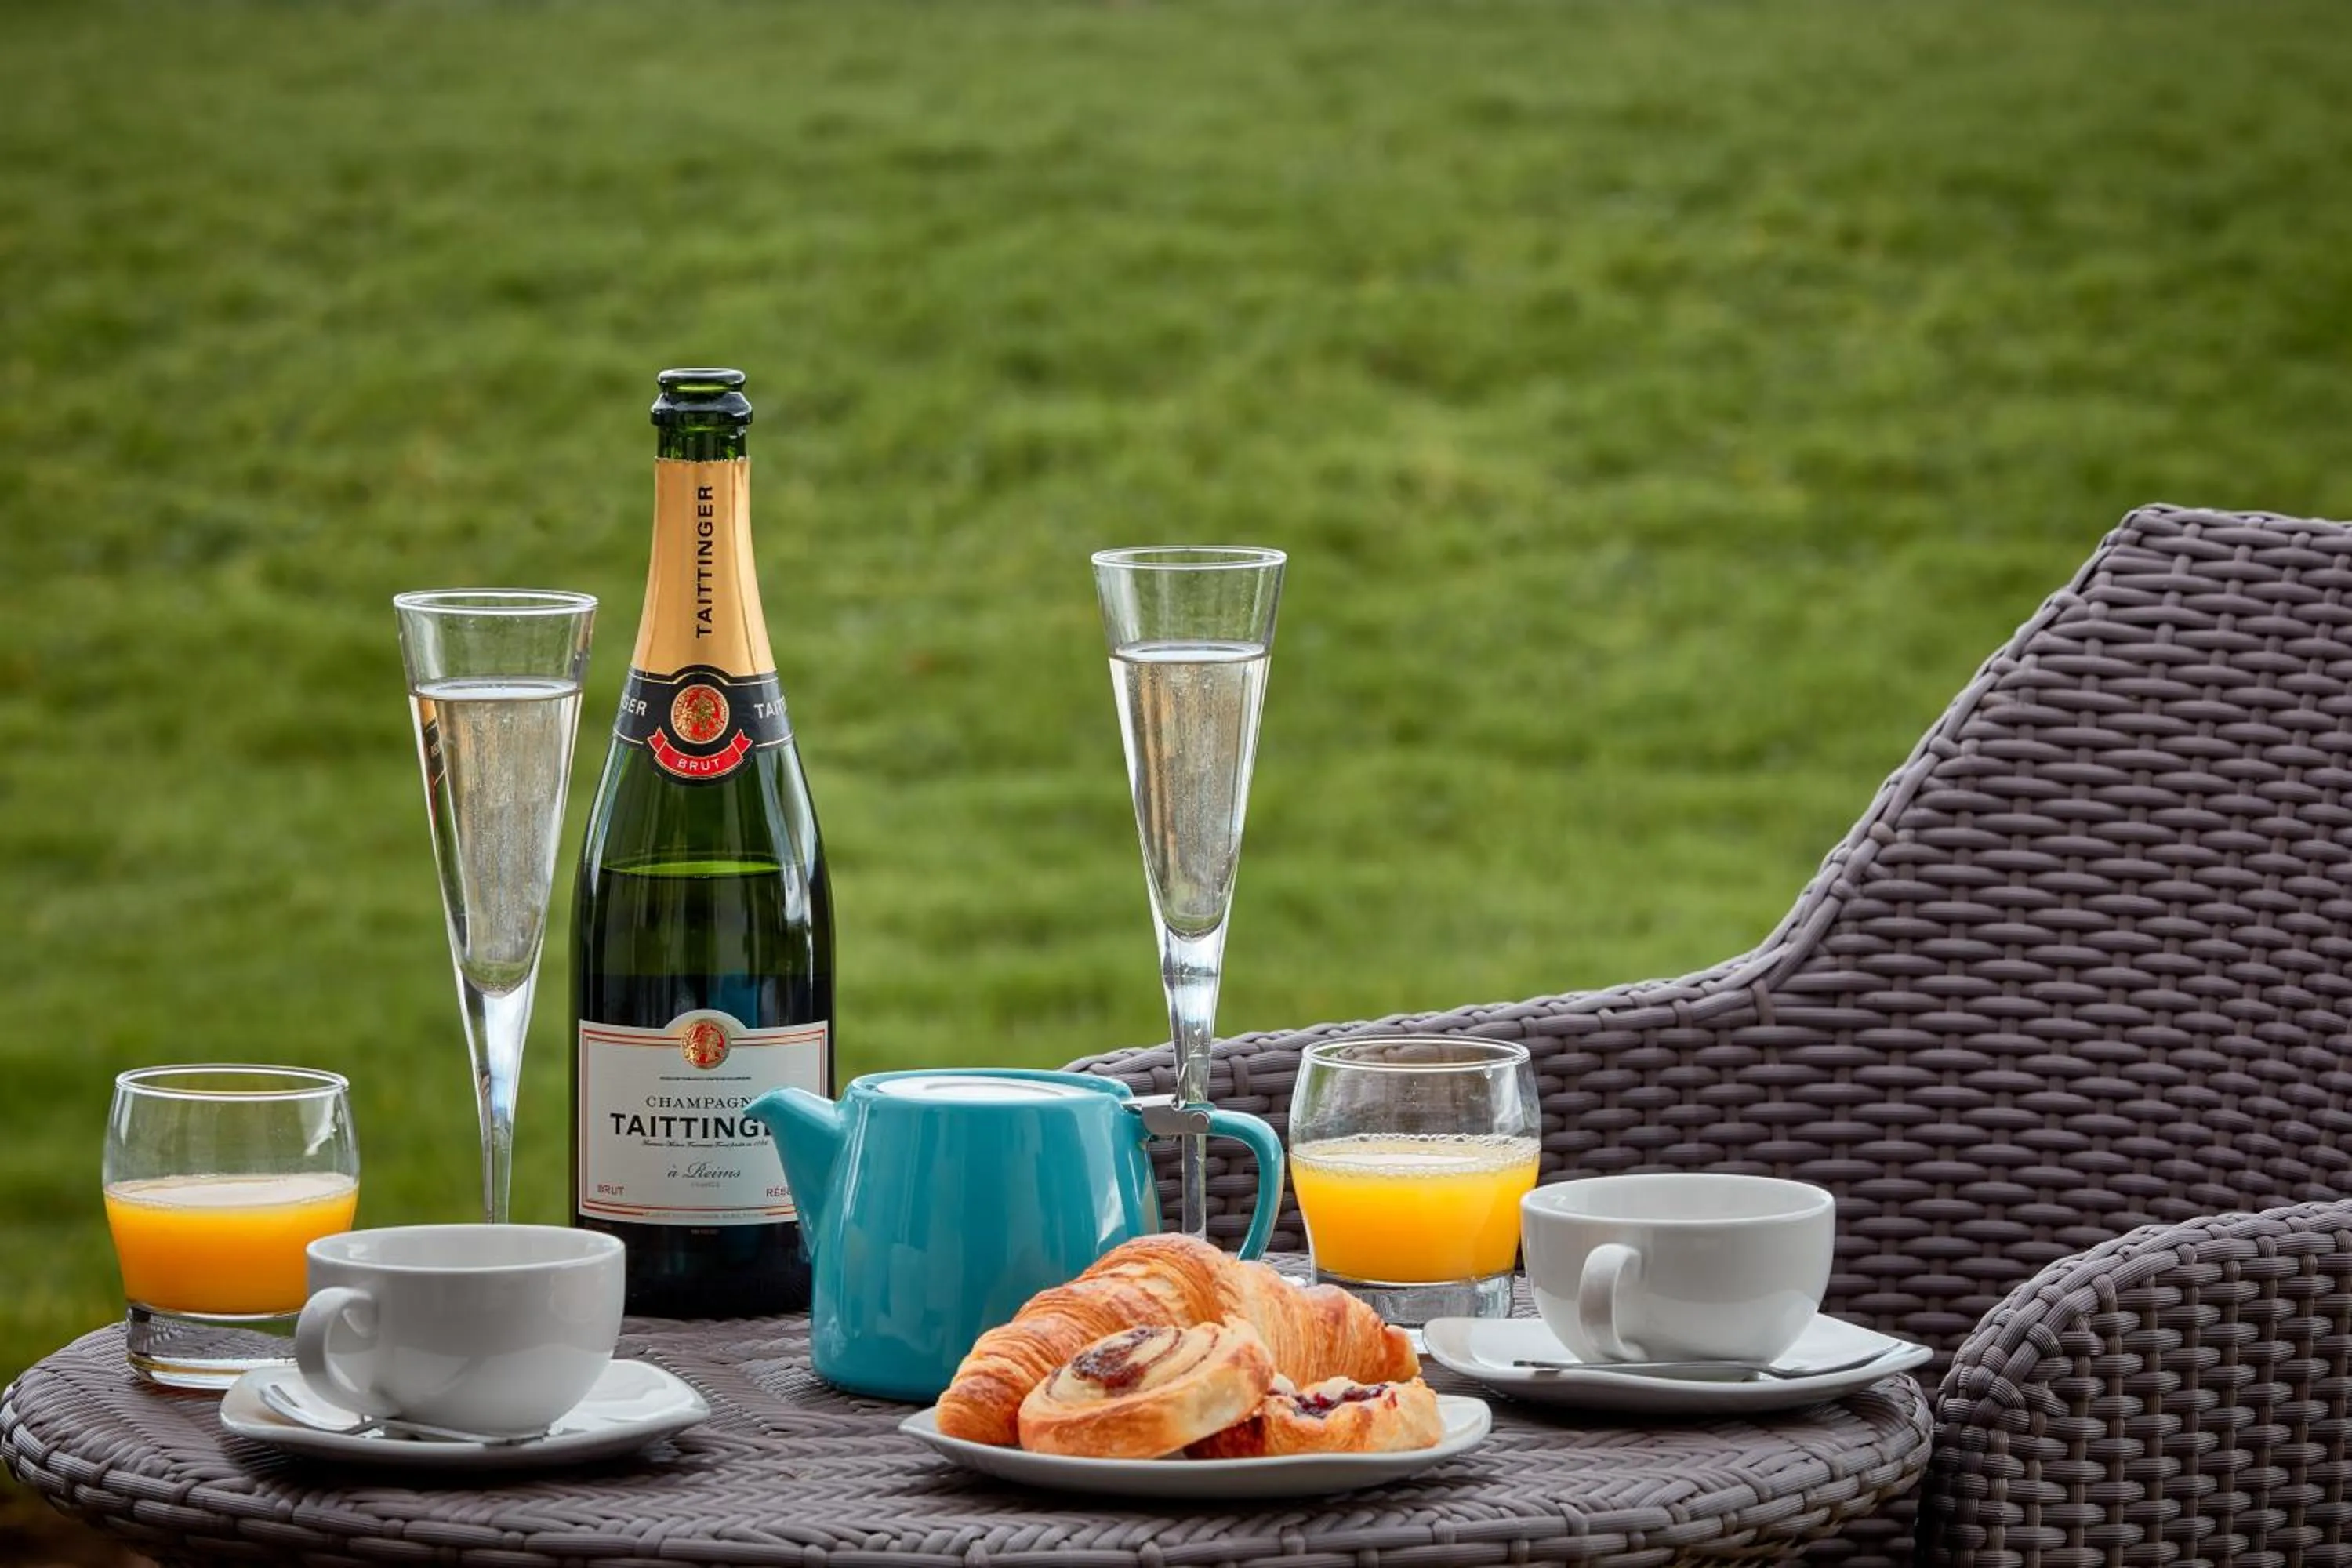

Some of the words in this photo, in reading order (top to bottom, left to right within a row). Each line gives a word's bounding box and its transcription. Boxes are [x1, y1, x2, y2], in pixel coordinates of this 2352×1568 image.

[696, 485, 713, 639] TAITTINGER
[677, 758, 720, 771] BRUT
[646, 1097, 754, 1109] CHAMPAGN
[667, 1164, 677, 1178] à
[682, 1160, 741, 1178] Reims
[597, 1184, 625, 1196] BRUT
